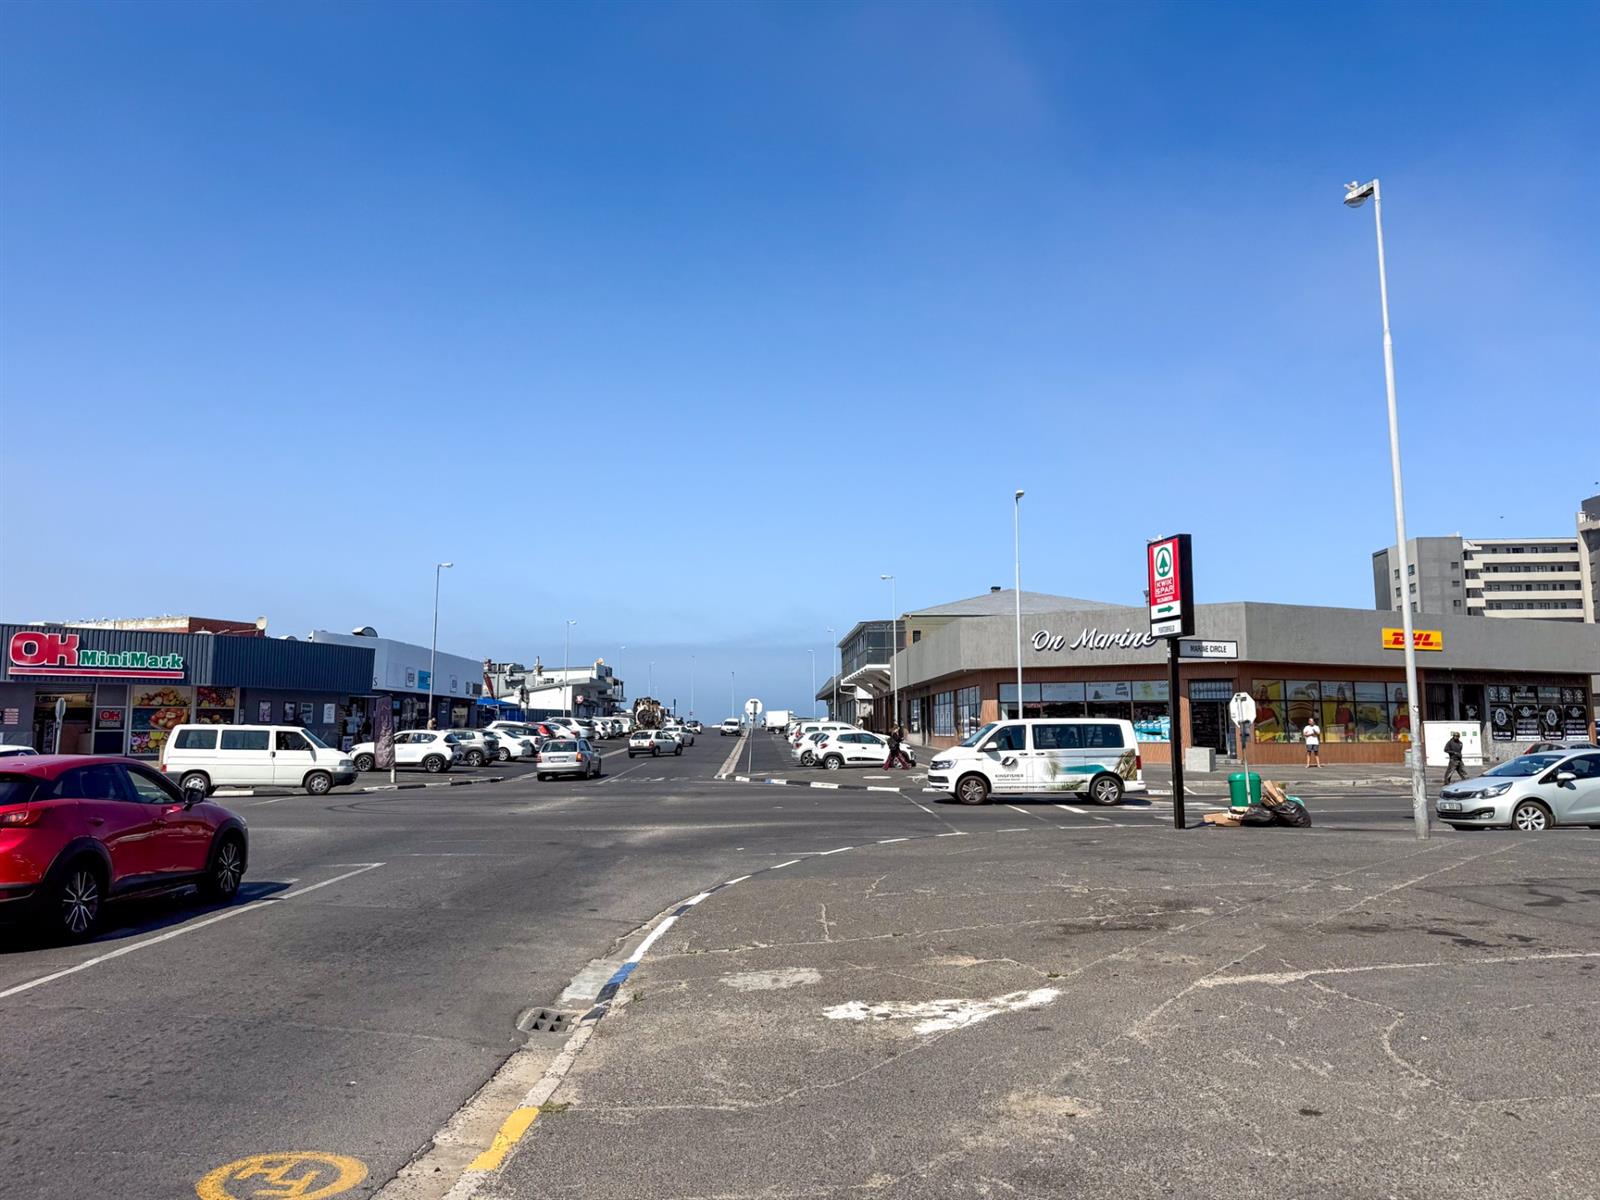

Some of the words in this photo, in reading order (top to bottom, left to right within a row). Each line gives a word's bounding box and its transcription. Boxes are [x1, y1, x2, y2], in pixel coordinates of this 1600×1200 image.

[1156, 578, 1173, 588] KWIK
[1155, 585, 1174, 596] SPAR
[1032, 629, 1065, 651] On
[1070, 628, 1157, 650] Marine
[10, 631, 79, 666] OK
[80, 650, 183, 668] MiniMark
[1190, 644, 1209, 653] MARINE
[1209, 645, 1227, 654] CIRCLE
[99, 709, 122, 721] OK
